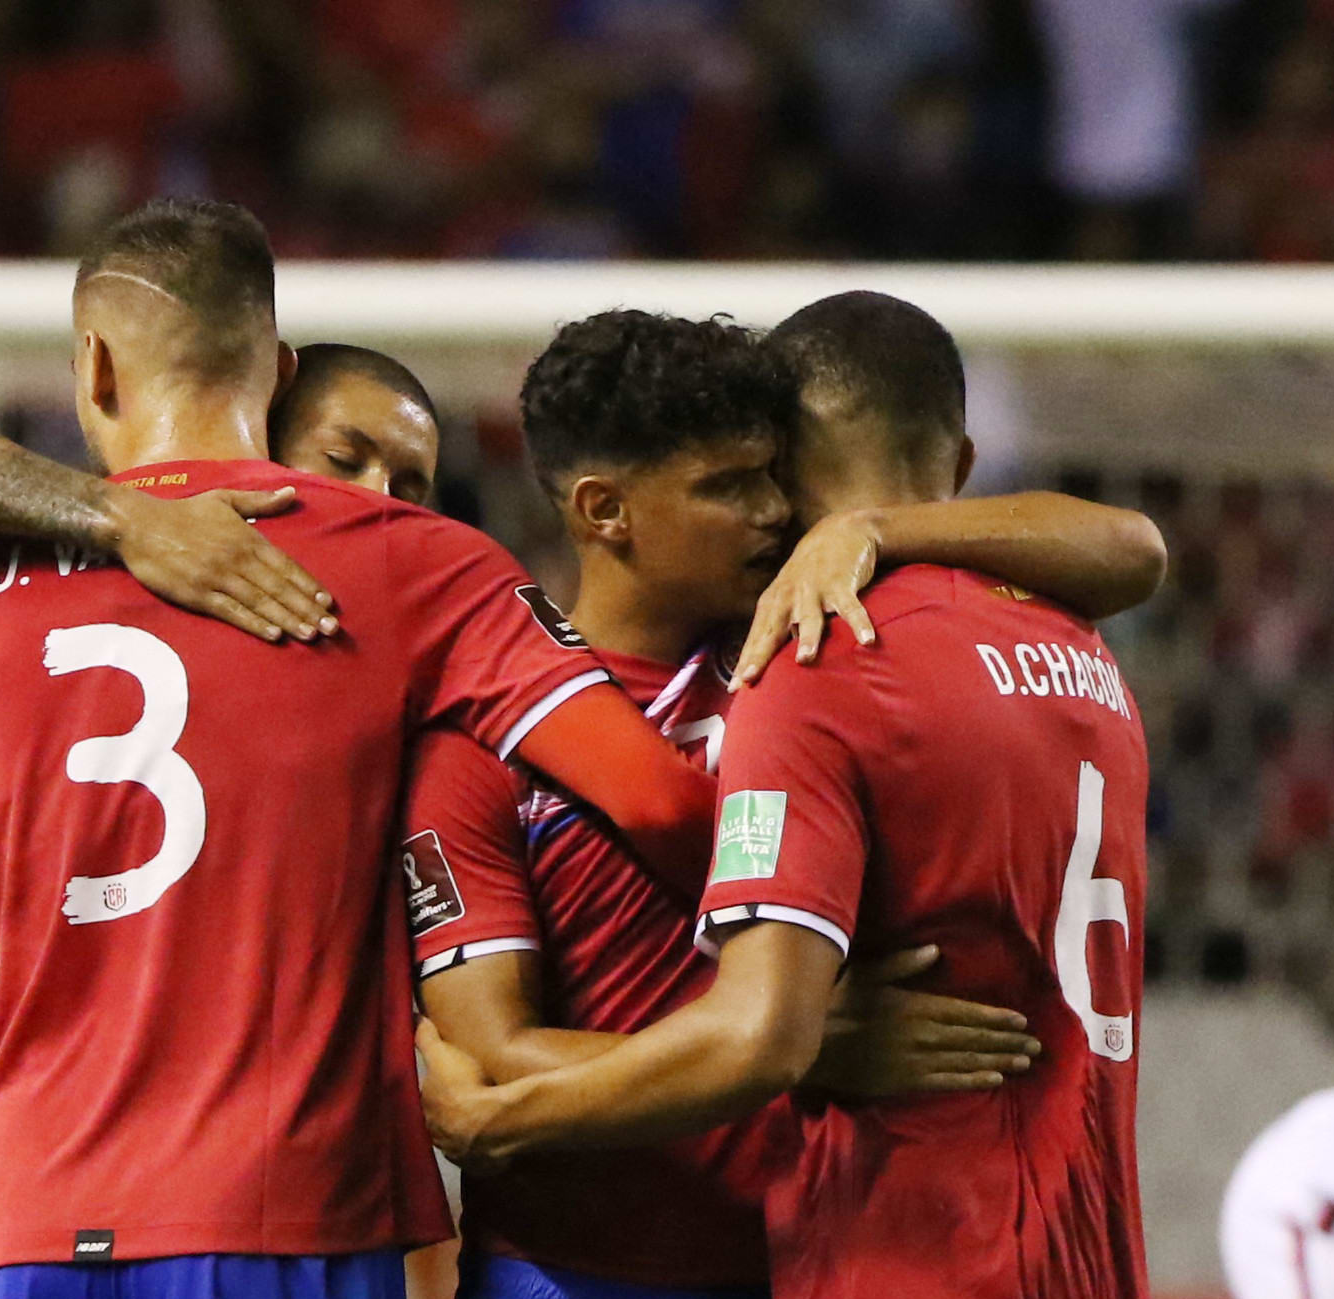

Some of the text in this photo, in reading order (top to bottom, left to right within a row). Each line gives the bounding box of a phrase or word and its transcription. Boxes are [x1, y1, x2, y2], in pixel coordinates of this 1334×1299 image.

[43, 622, 207, 926] 3
[741, 843, 770, 855] FIFA
[1053, 759, 1134, 1063] 6
